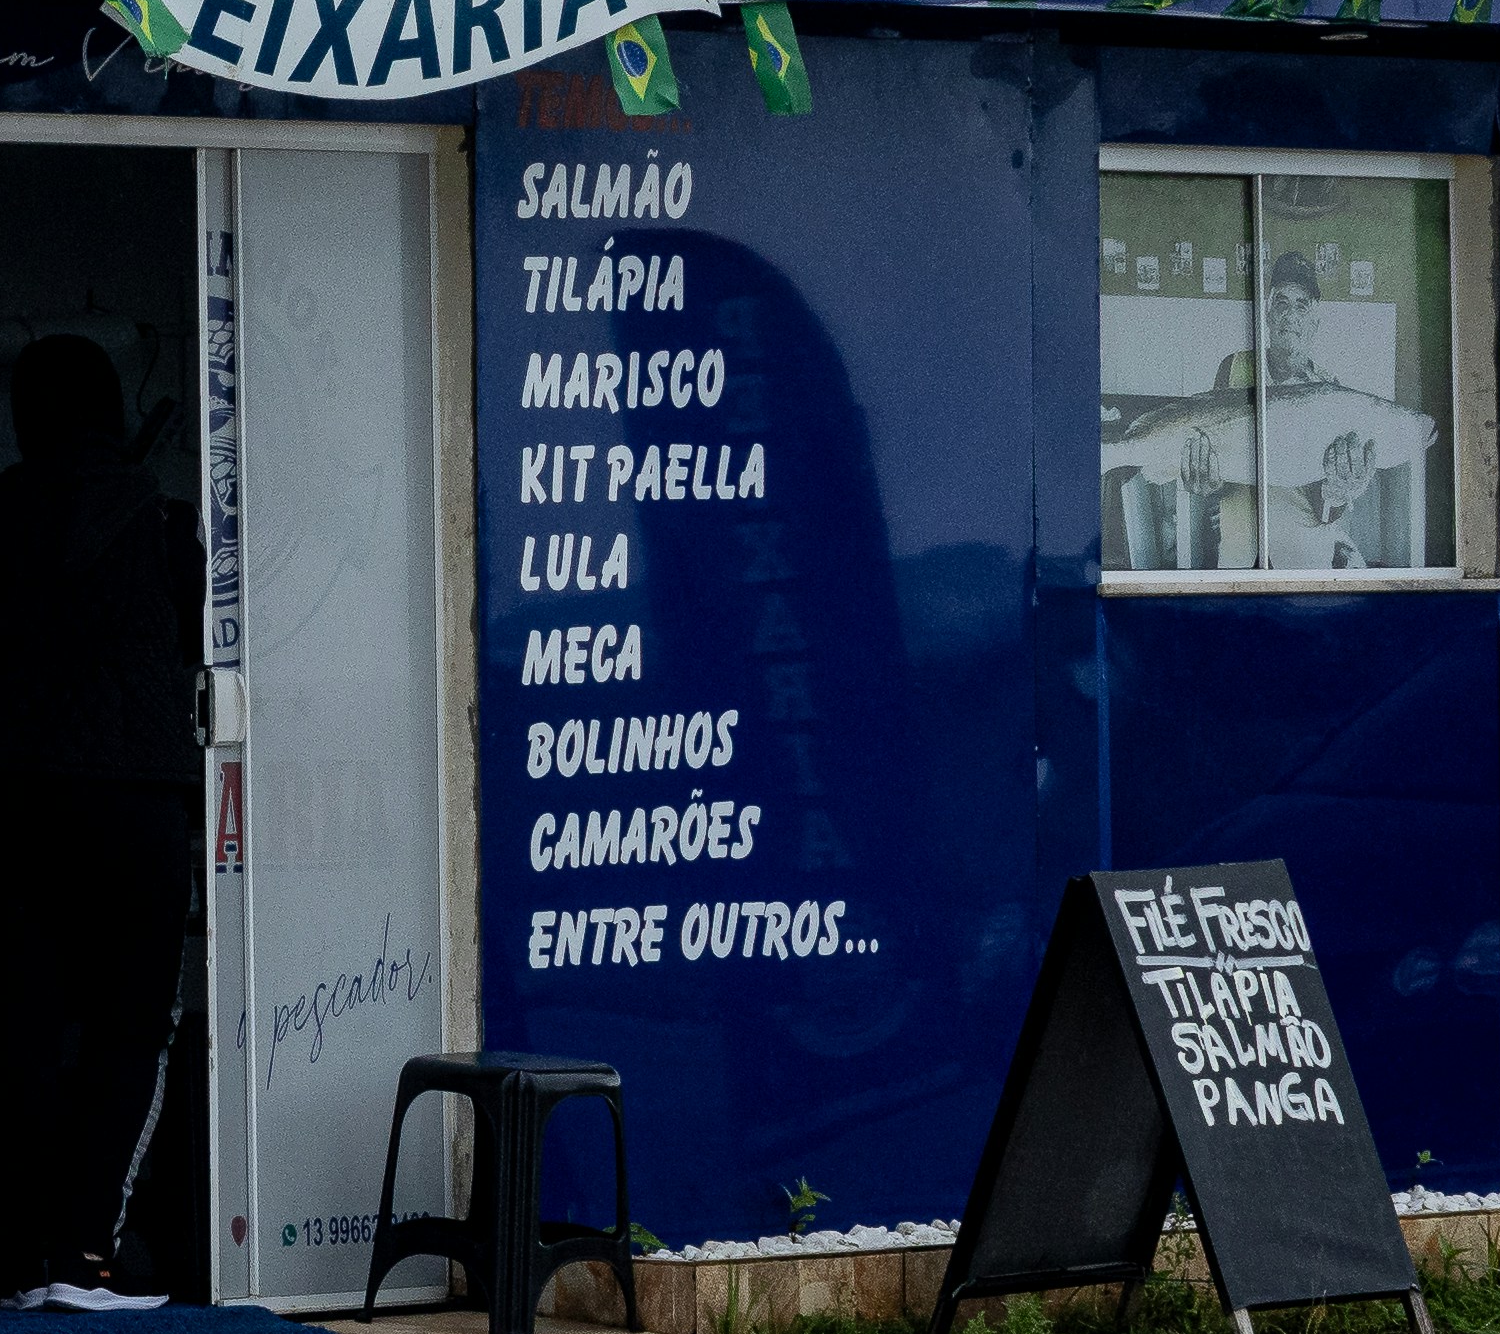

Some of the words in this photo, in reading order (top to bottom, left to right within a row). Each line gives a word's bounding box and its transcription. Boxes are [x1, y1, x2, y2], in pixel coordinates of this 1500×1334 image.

[517, 149, 693, 219] SALMÃO
[523, 237, 684, 313] TILÁPIA
[521, 349, 725, 413] MARISCO
[521, 443, 595, 504] KIT
[607, 443, 765, 501] PAELLA
[520, 533, 628, 591] LULA
[522, 625, 641, 685] MECA
[526, 710, 738, 779] BOLINHOS
[530, 789, 761, 871] CAMARÕES
[529, 905, 667, 968] ENTRE
[681, 900, 879, 960] OUTROS...
[1190, 886, 1311, 953] FRESCO
[266, 912, 435, 1091] pescador.
[1171, 1016, 1332, 1075] SALMÃO
[1192, 1072, 1345, 1127] PANGA
[302, 1217, 324, 1247] 13
